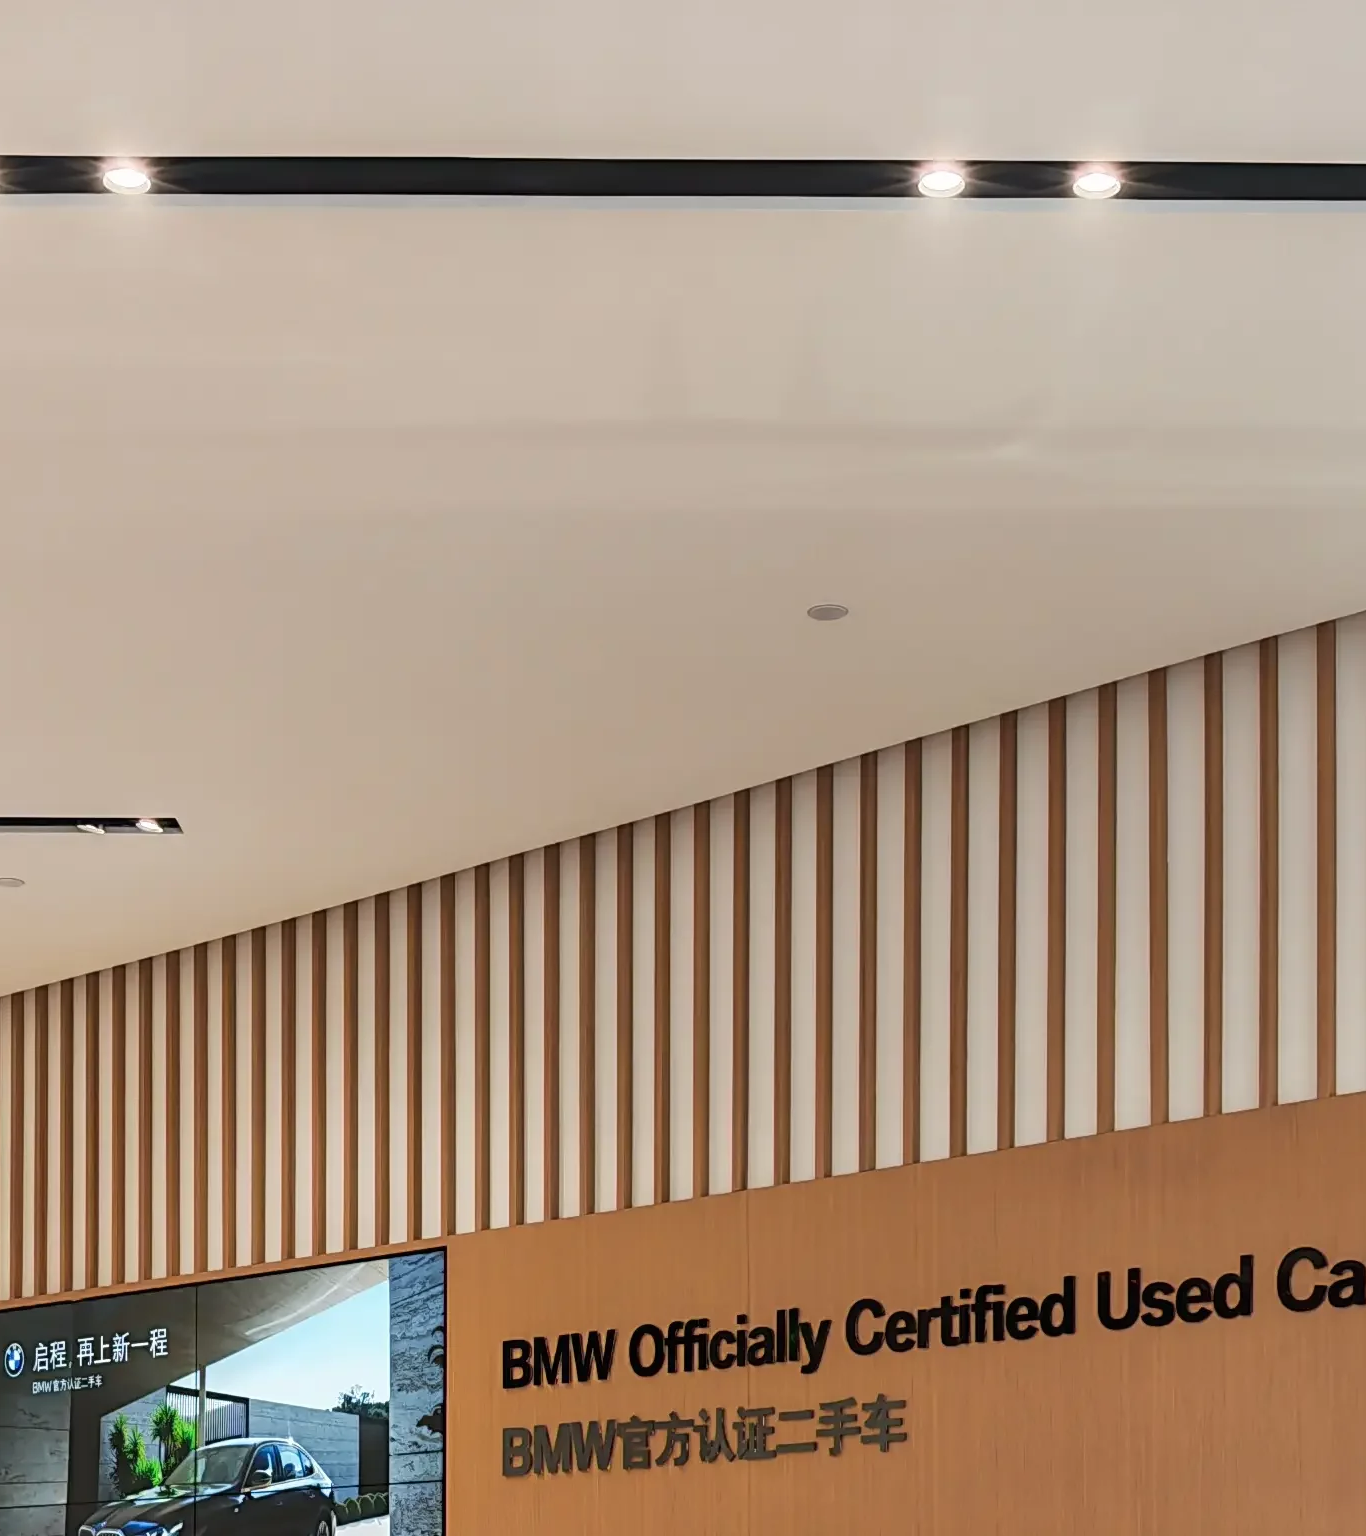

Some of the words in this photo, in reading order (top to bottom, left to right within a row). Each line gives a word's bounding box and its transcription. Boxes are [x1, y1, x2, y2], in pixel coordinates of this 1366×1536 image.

[502, 1329, 616, 1390] BMW
[628, 1308, 832, 1375] Officially
[844, 1276, 1076, 1358] Certified
[1096, 1255, 1255, 1331] Used
[502, 1393, 909, 1479] BMW官方认证二手车
